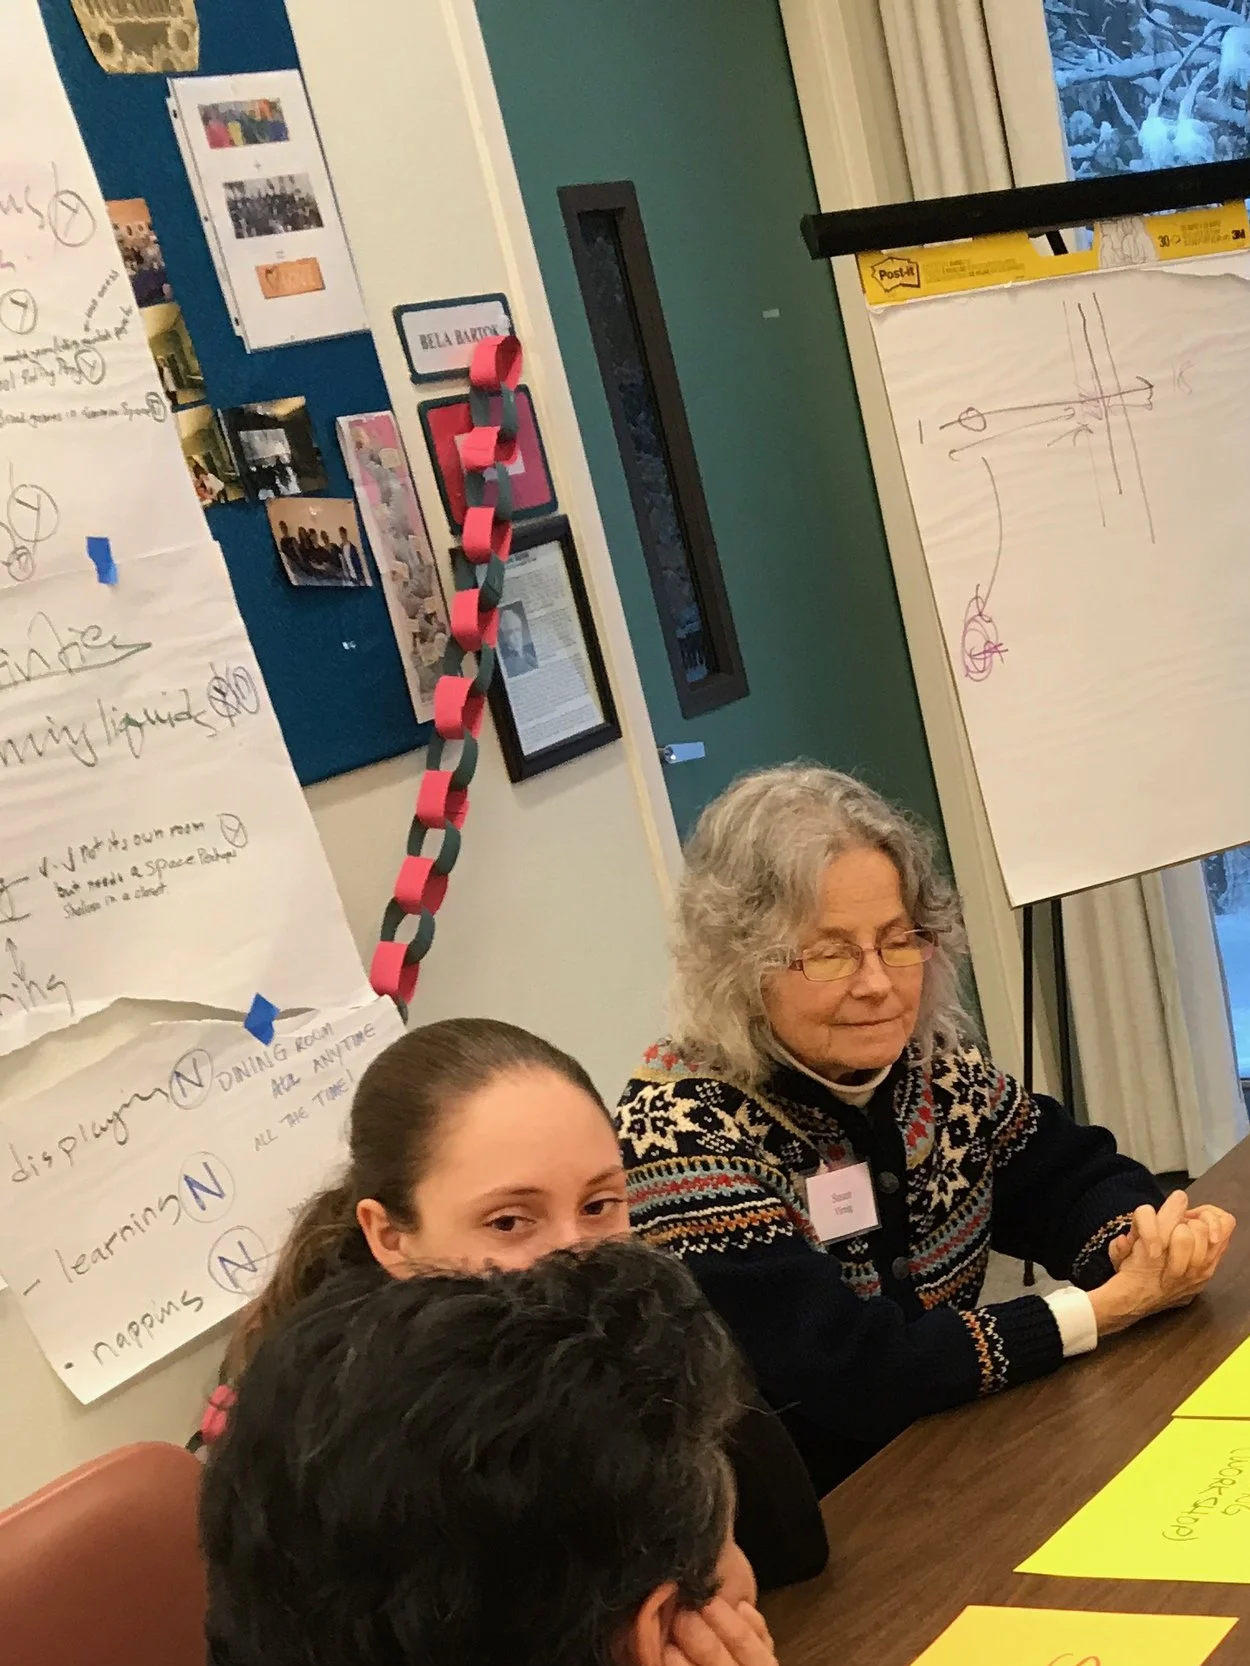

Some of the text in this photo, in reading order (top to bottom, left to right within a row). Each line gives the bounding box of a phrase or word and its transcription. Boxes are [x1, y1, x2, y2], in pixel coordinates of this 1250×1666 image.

[879, 266, 916, 281] Post-it
[418, 328, 453, 350] BELA
[133, 827, 165, 847] own
[169, 820, 206, 837] room
[215, 1021, 335, 1093] DINING ROOM
[311, 1022, 377, 1074] ANYTIME
[253, 1128, 279, 1152] ALL
[278, 1105, 310, 1128] THE
[54, 1189, 182, 1284] learning
[90, 1289, 205, 1368] napping
